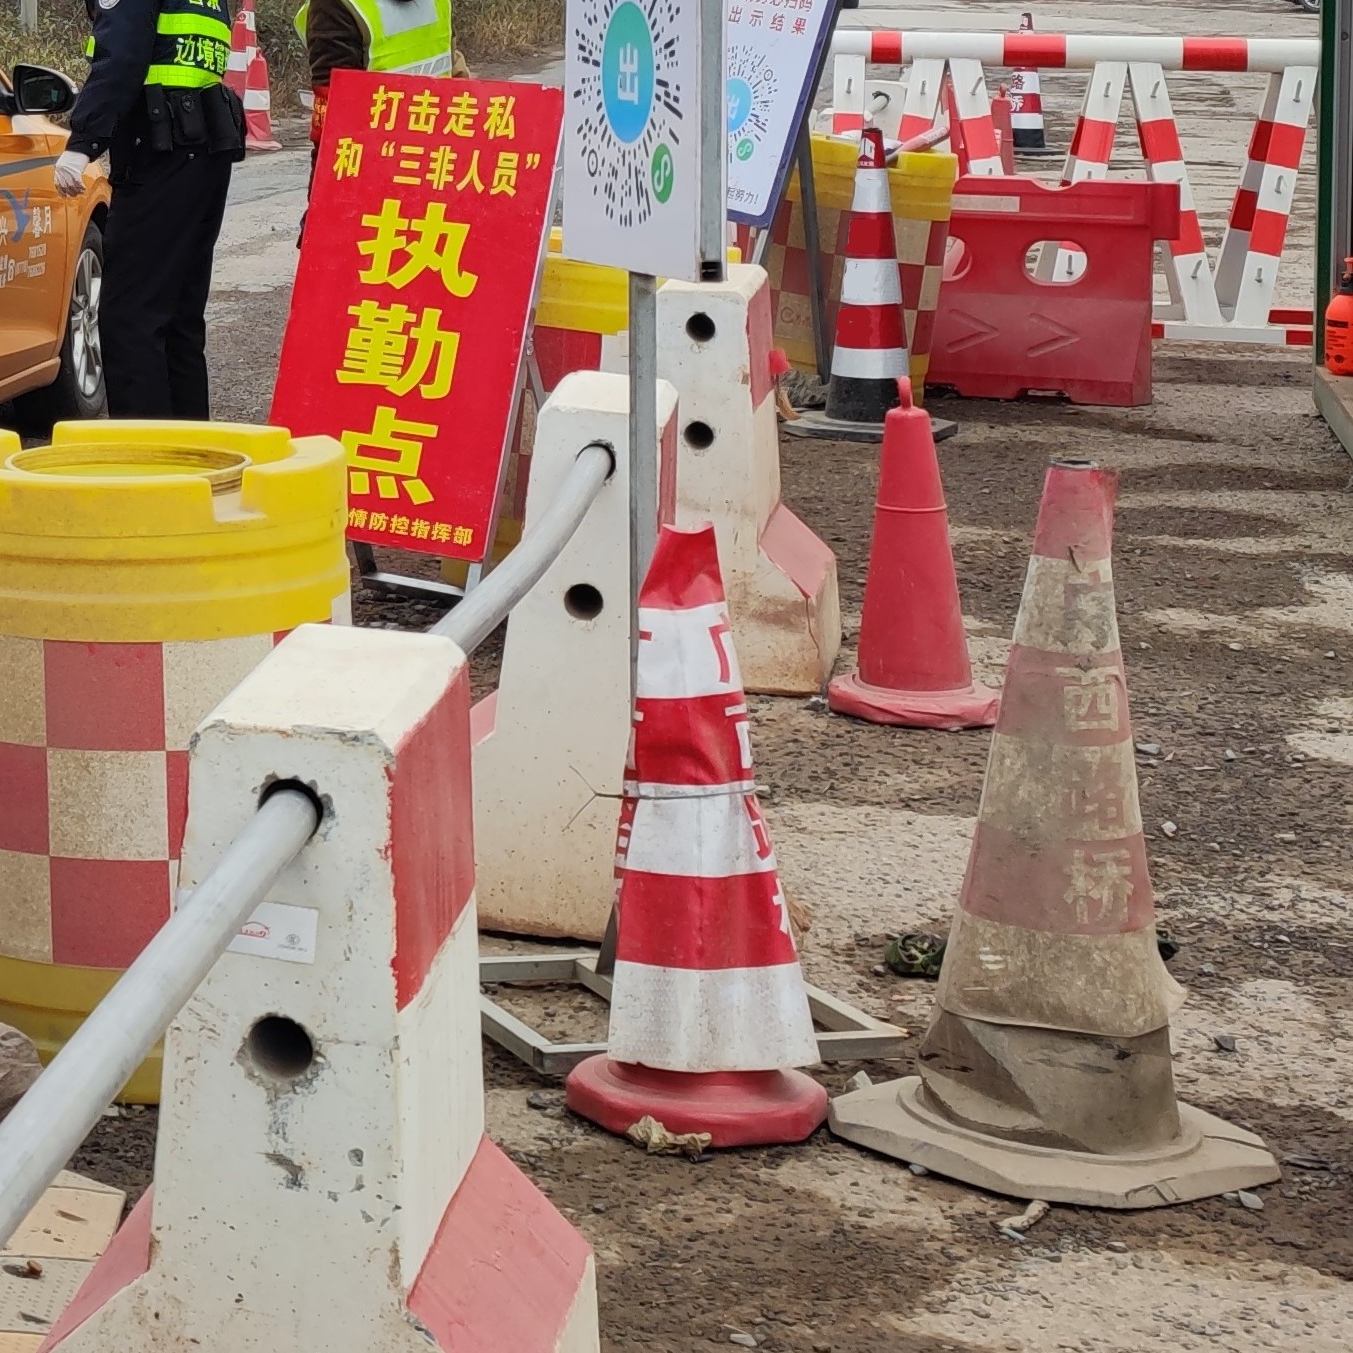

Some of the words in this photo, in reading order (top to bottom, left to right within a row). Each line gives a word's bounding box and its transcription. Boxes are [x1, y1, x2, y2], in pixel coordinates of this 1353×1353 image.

[727, 4, 807, 36] 出示结果
[174, 35, 231, 76] 边境管
[369, 85, 516, 139] 打击走私
[335, 198, 479, 506] 执勤点
[348, 507, 474, 547] 情防控指挥部
